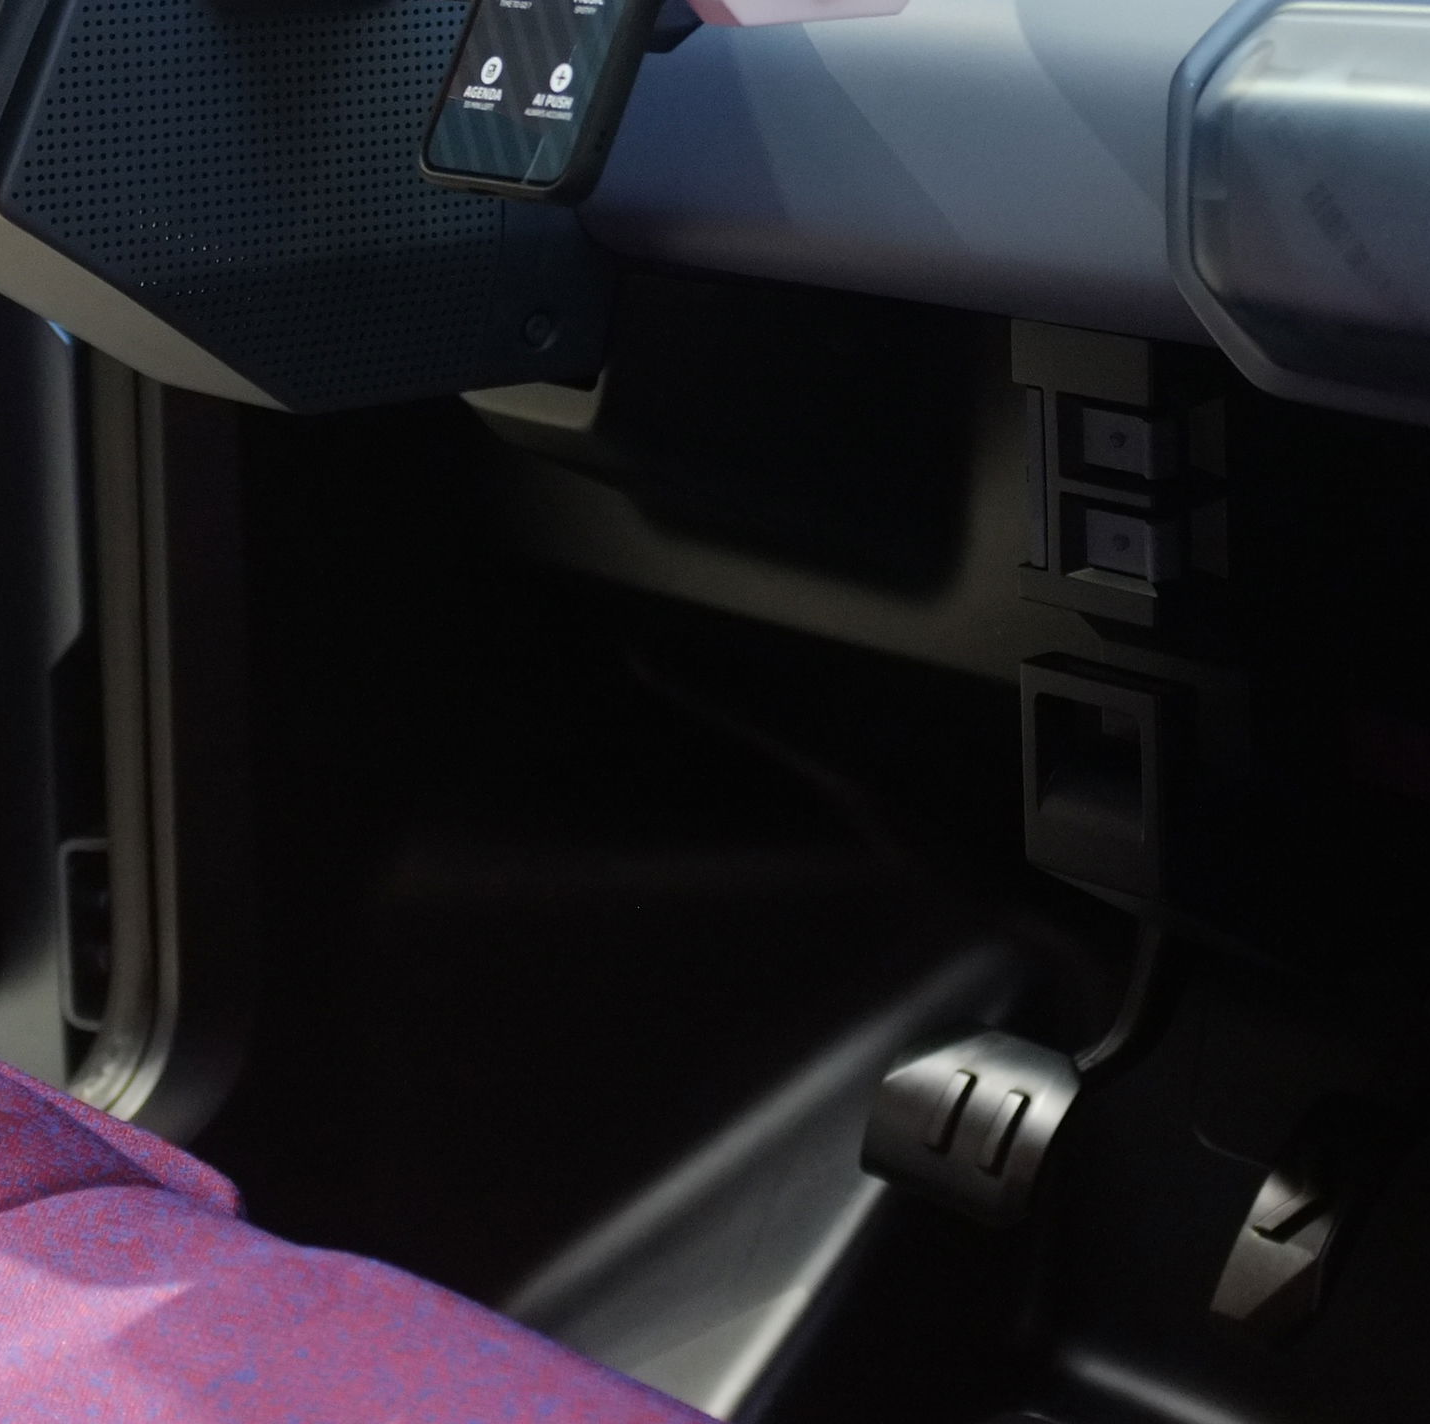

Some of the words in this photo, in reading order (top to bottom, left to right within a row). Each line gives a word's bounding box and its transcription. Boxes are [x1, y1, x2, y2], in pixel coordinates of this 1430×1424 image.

[463, 85, 502, 101] AGENDA
[532, 93, 545, 106] AI
[545, 94, 574, 109] PUSH
